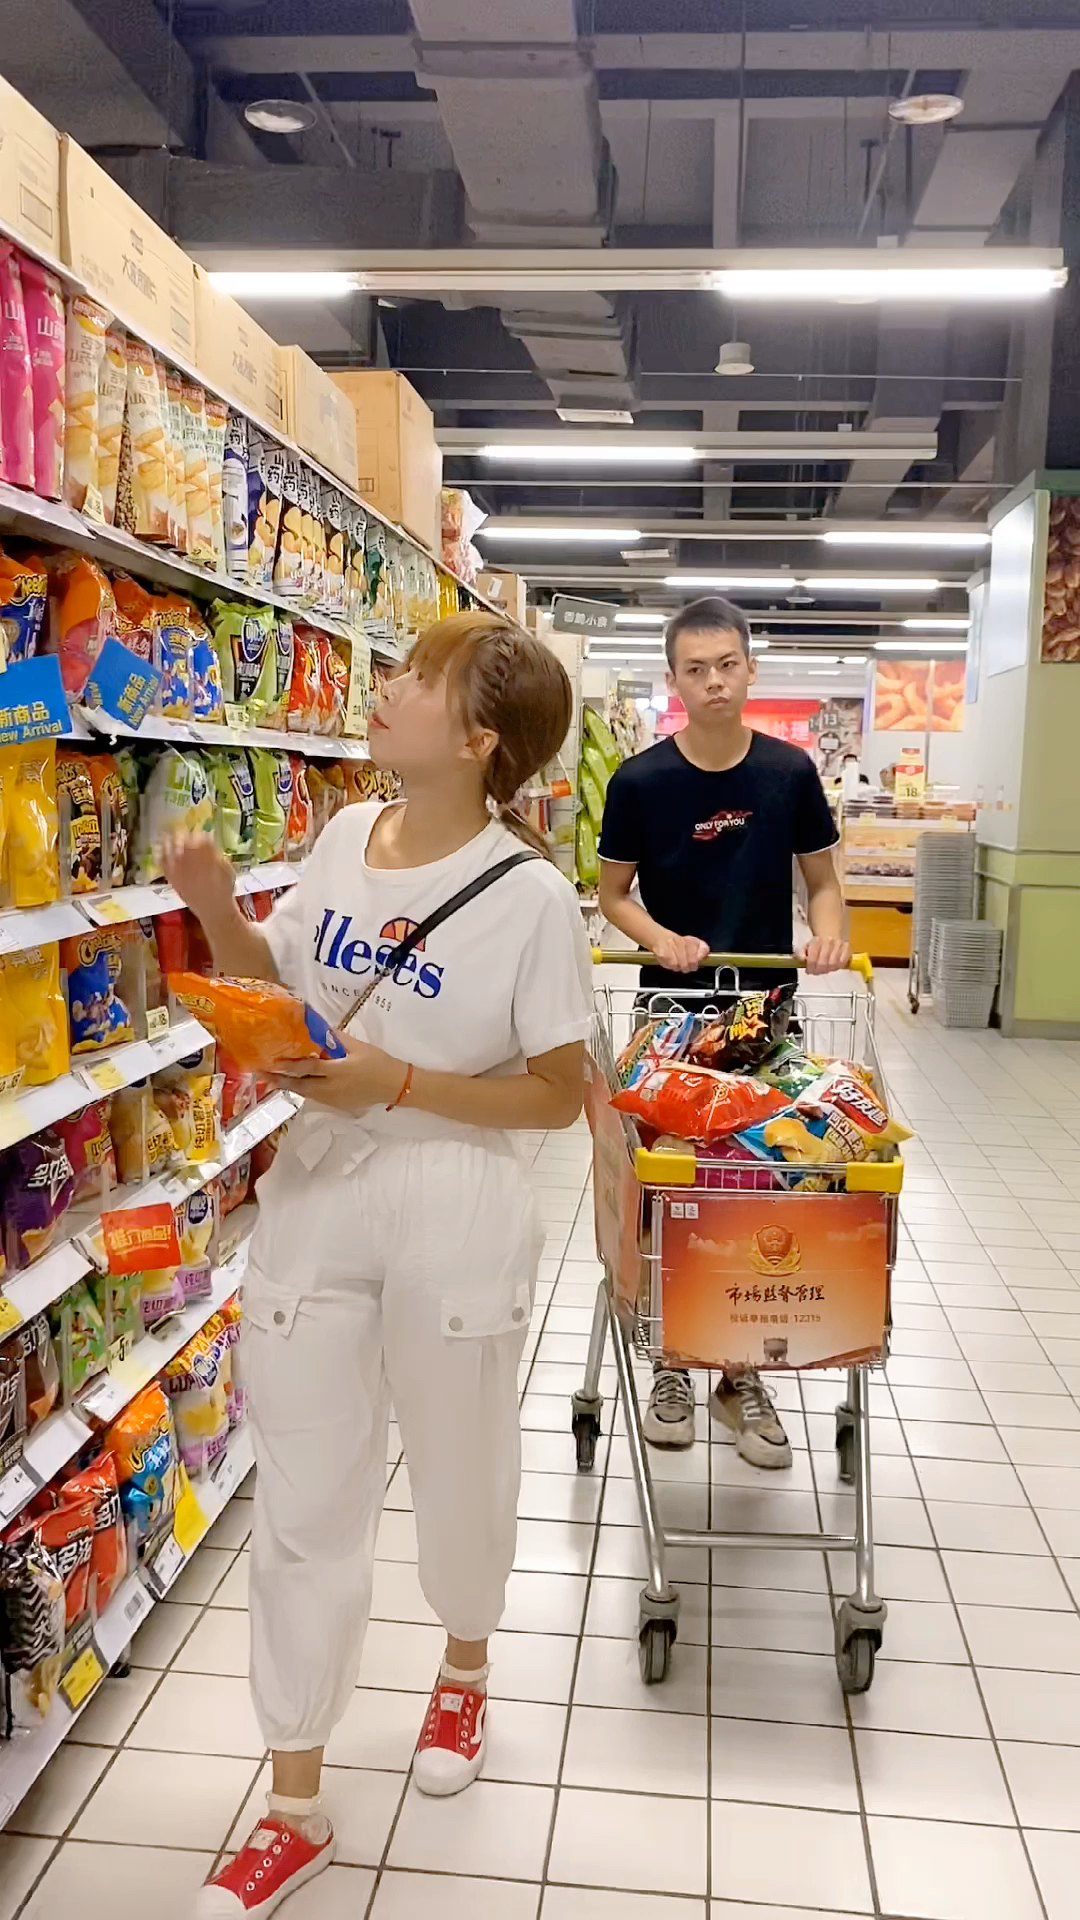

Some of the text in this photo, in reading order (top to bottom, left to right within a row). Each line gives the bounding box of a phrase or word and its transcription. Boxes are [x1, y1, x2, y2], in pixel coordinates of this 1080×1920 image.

[22, 719, 63, 738] Arrival
[694, 821, 713, 831] ONLY
[729, 817, 745, 827] YOU
